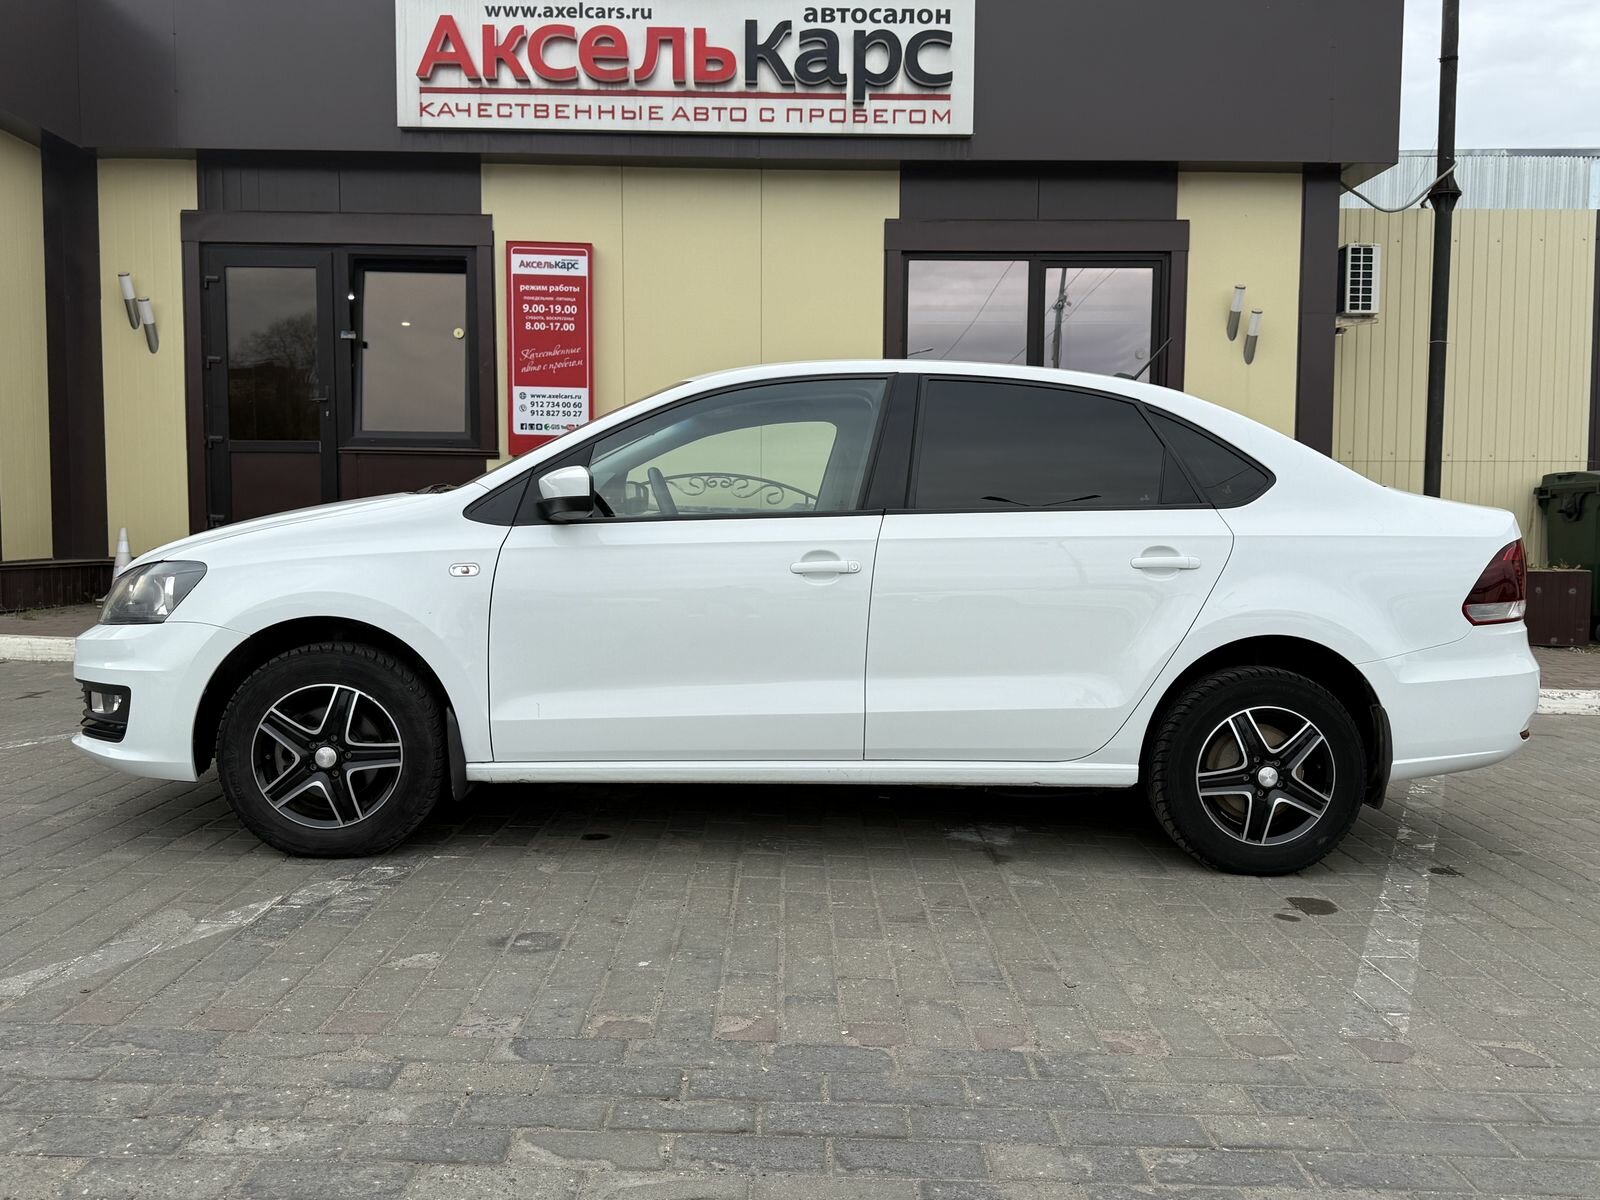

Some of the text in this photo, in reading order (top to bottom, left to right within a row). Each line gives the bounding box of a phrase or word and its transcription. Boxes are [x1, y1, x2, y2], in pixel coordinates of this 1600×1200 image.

[484, 2, 653, 20] www.axelcars.ru
[803, 6, 952, 25] автосалон
[415, 14, 954, 108] АксельКарс
[419, 101, 952, 124] КАЧЕСТВЕННЫЕ АВТО С ПРОБЕГОМ
[518, 259, 580, 271] АксельКарс
[519, 284, 580, 293] режим работы
[522, 303, 578, 314] 9.00-19.00
[525, 321, 576, 332] 8.00-17.00
